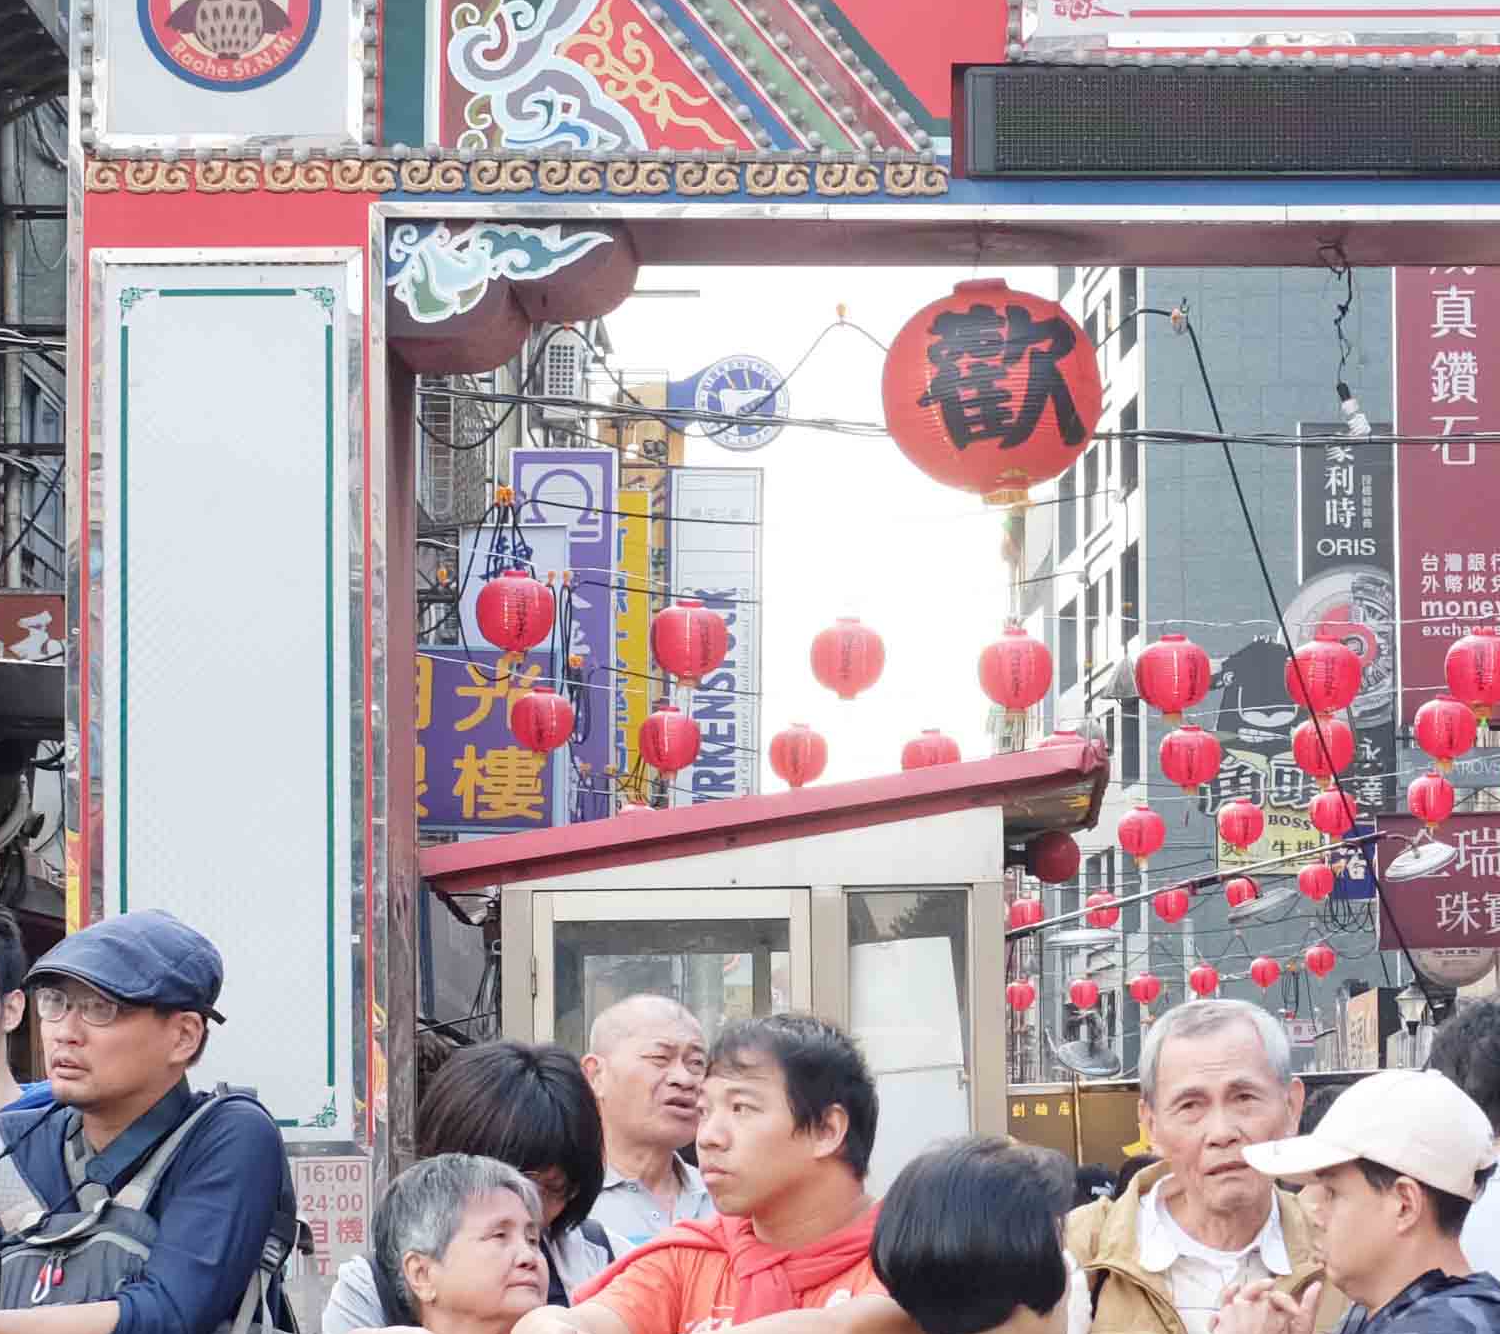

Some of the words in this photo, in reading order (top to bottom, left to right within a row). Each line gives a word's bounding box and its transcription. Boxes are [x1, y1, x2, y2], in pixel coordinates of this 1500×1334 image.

[171, 36, 229, 78] Raohe
[916, 304, 1087, 451] 歡
[1426, 265, 1480, 466] 真鑽石
[1316, 538, 1376, 556] ORIS
[1268, 814, 1313, 830] BOSS
[301, 1194, 343, 1212] 24:00
